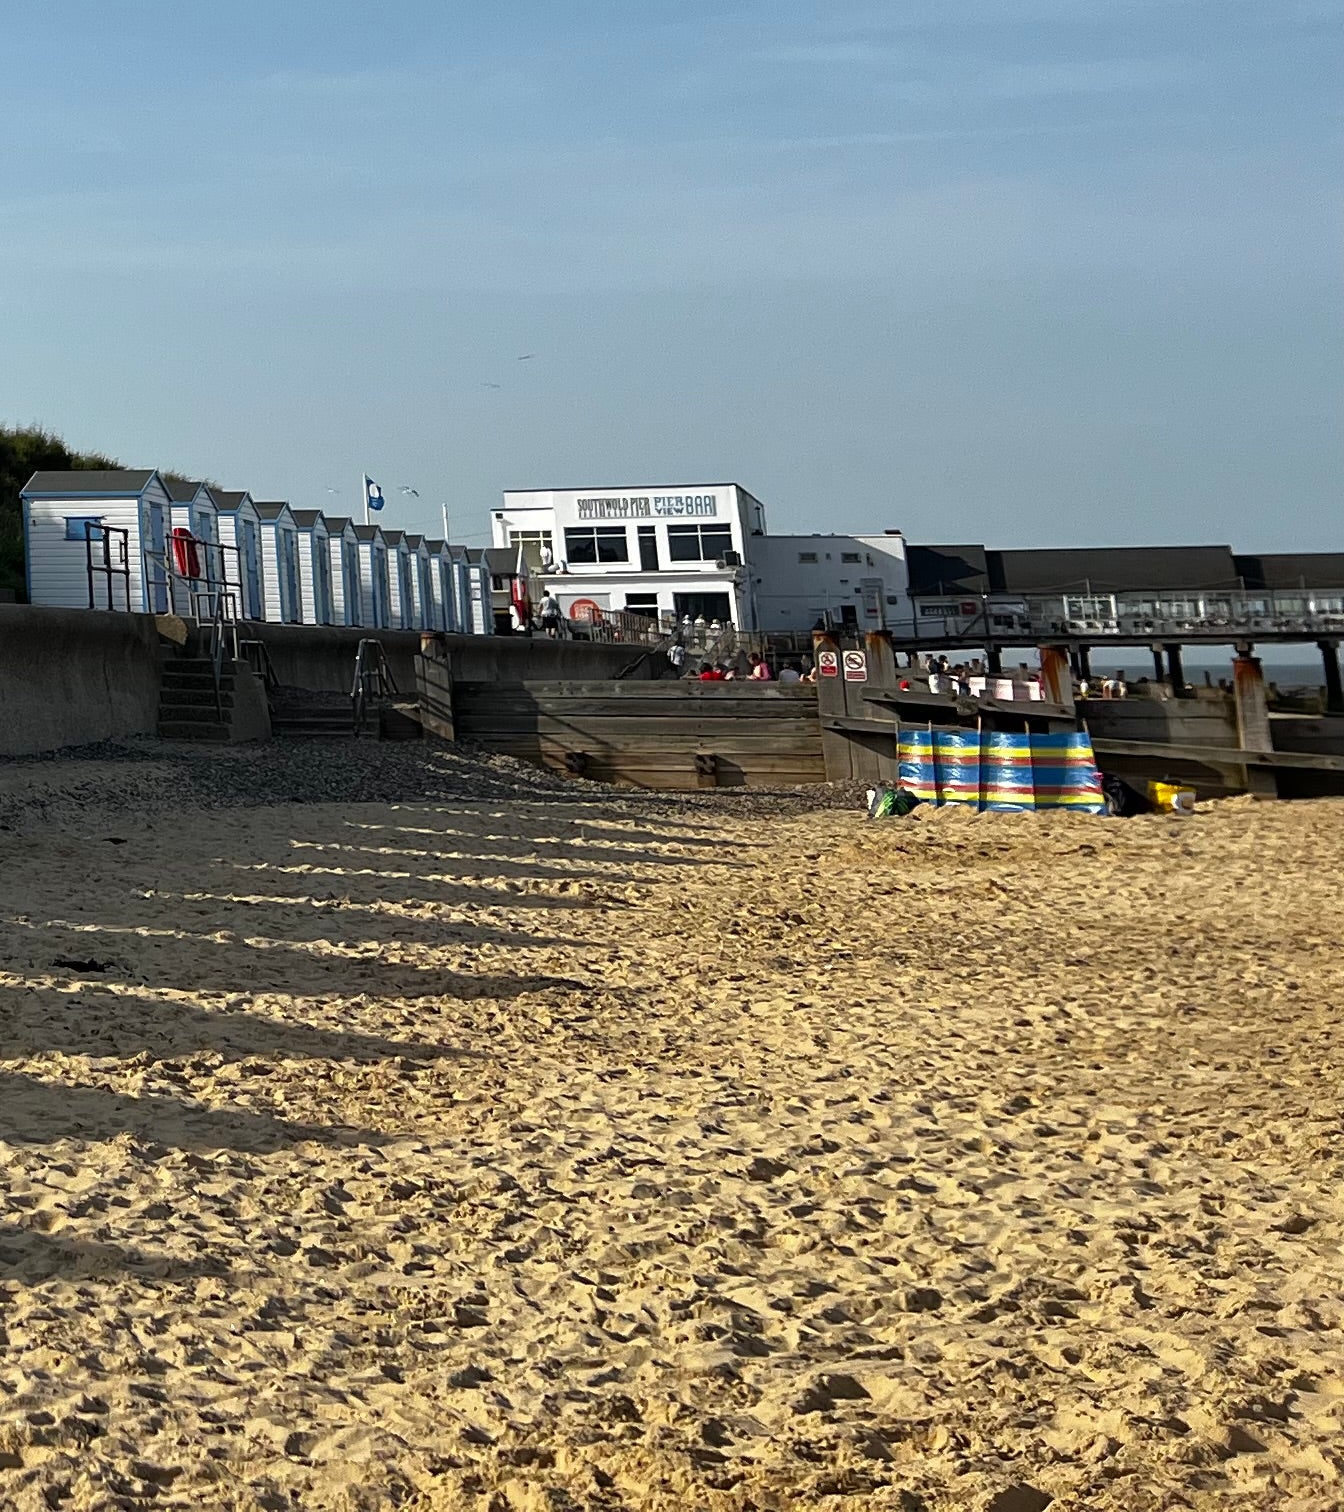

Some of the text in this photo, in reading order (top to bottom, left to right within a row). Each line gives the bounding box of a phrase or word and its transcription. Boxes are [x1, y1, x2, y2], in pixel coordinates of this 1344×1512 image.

[654, 496, 684, 507] PIER
[577, 497, 650, 518] SOUTHWOLD PIER
[655, 507, 684, 515] VIEW
